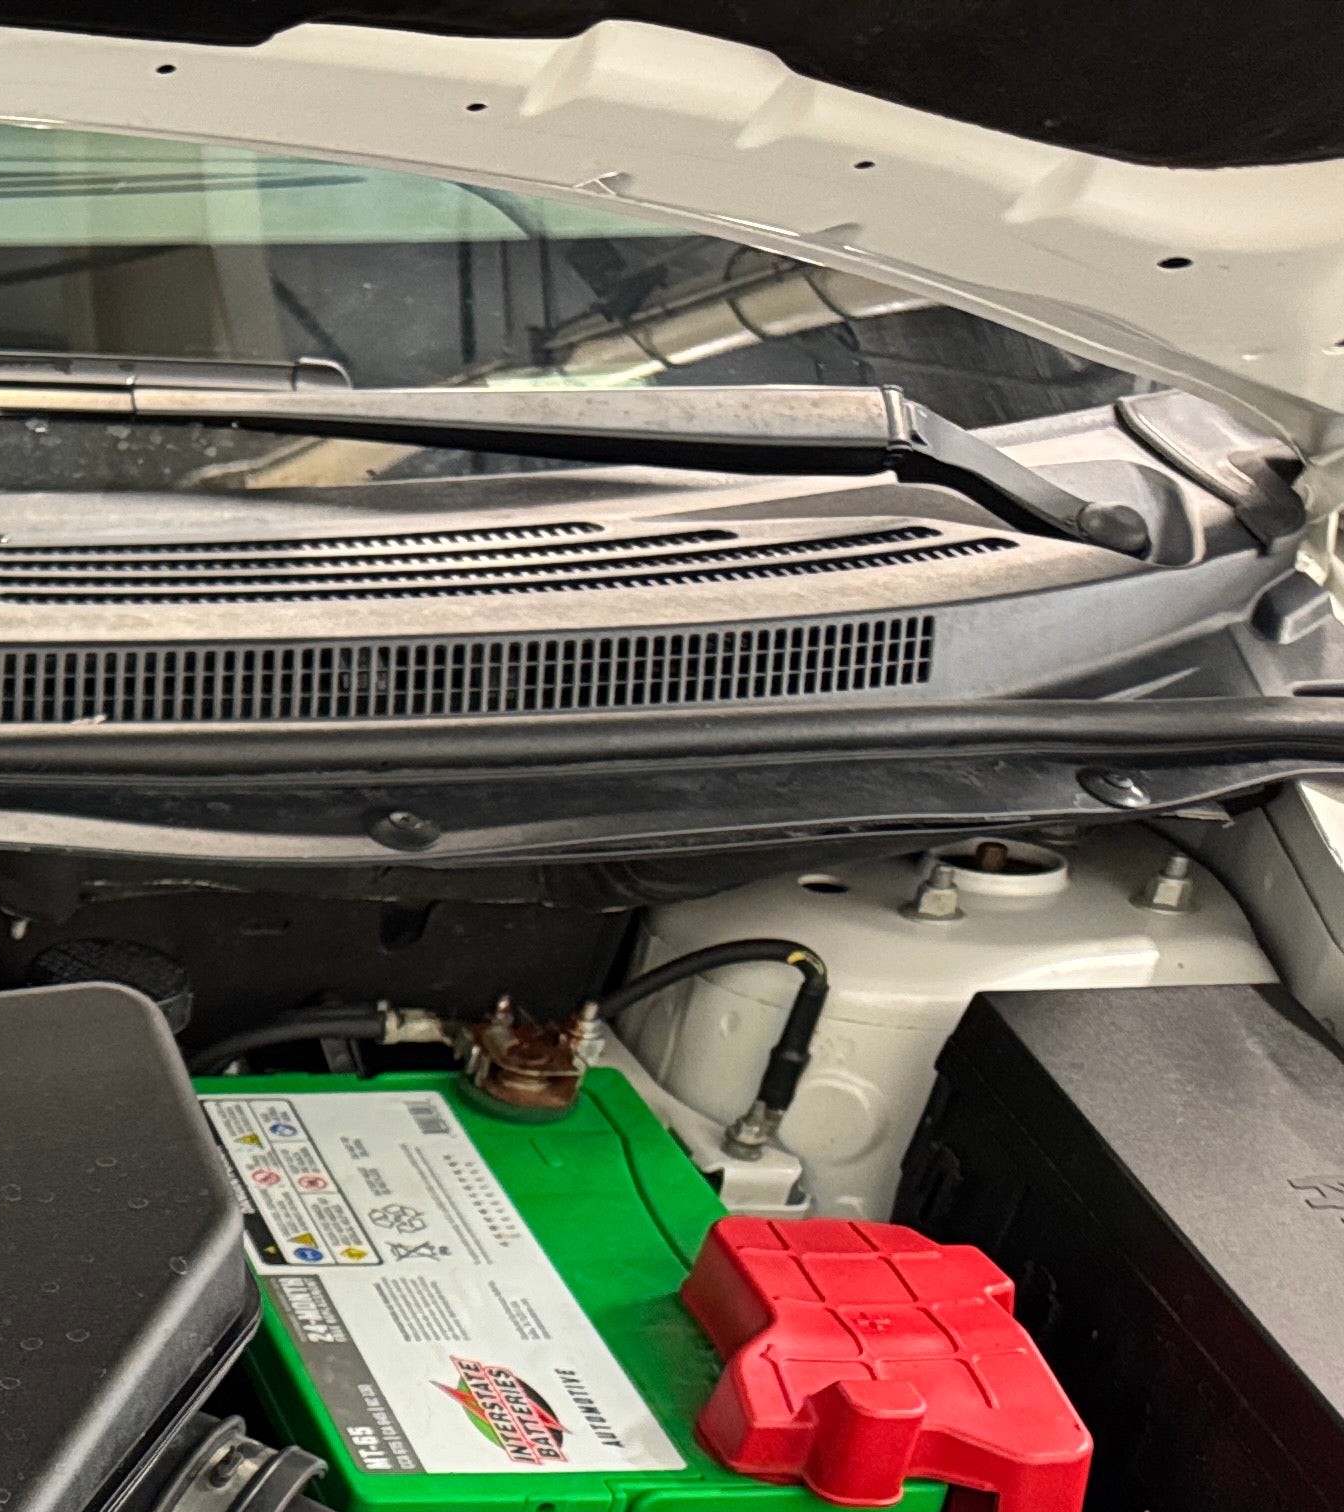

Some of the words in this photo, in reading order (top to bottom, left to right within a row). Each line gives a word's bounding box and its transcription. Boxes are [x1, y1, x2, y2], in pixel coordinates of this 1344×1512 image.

[346, 1426, 392, 1469] MT-65
[459, 1360, 536, 1463] INTERSTATE
[488, 1368, 561, 1458] BATTERIES
[555, 1368, 625, 1448] AUTOMOTIVE
